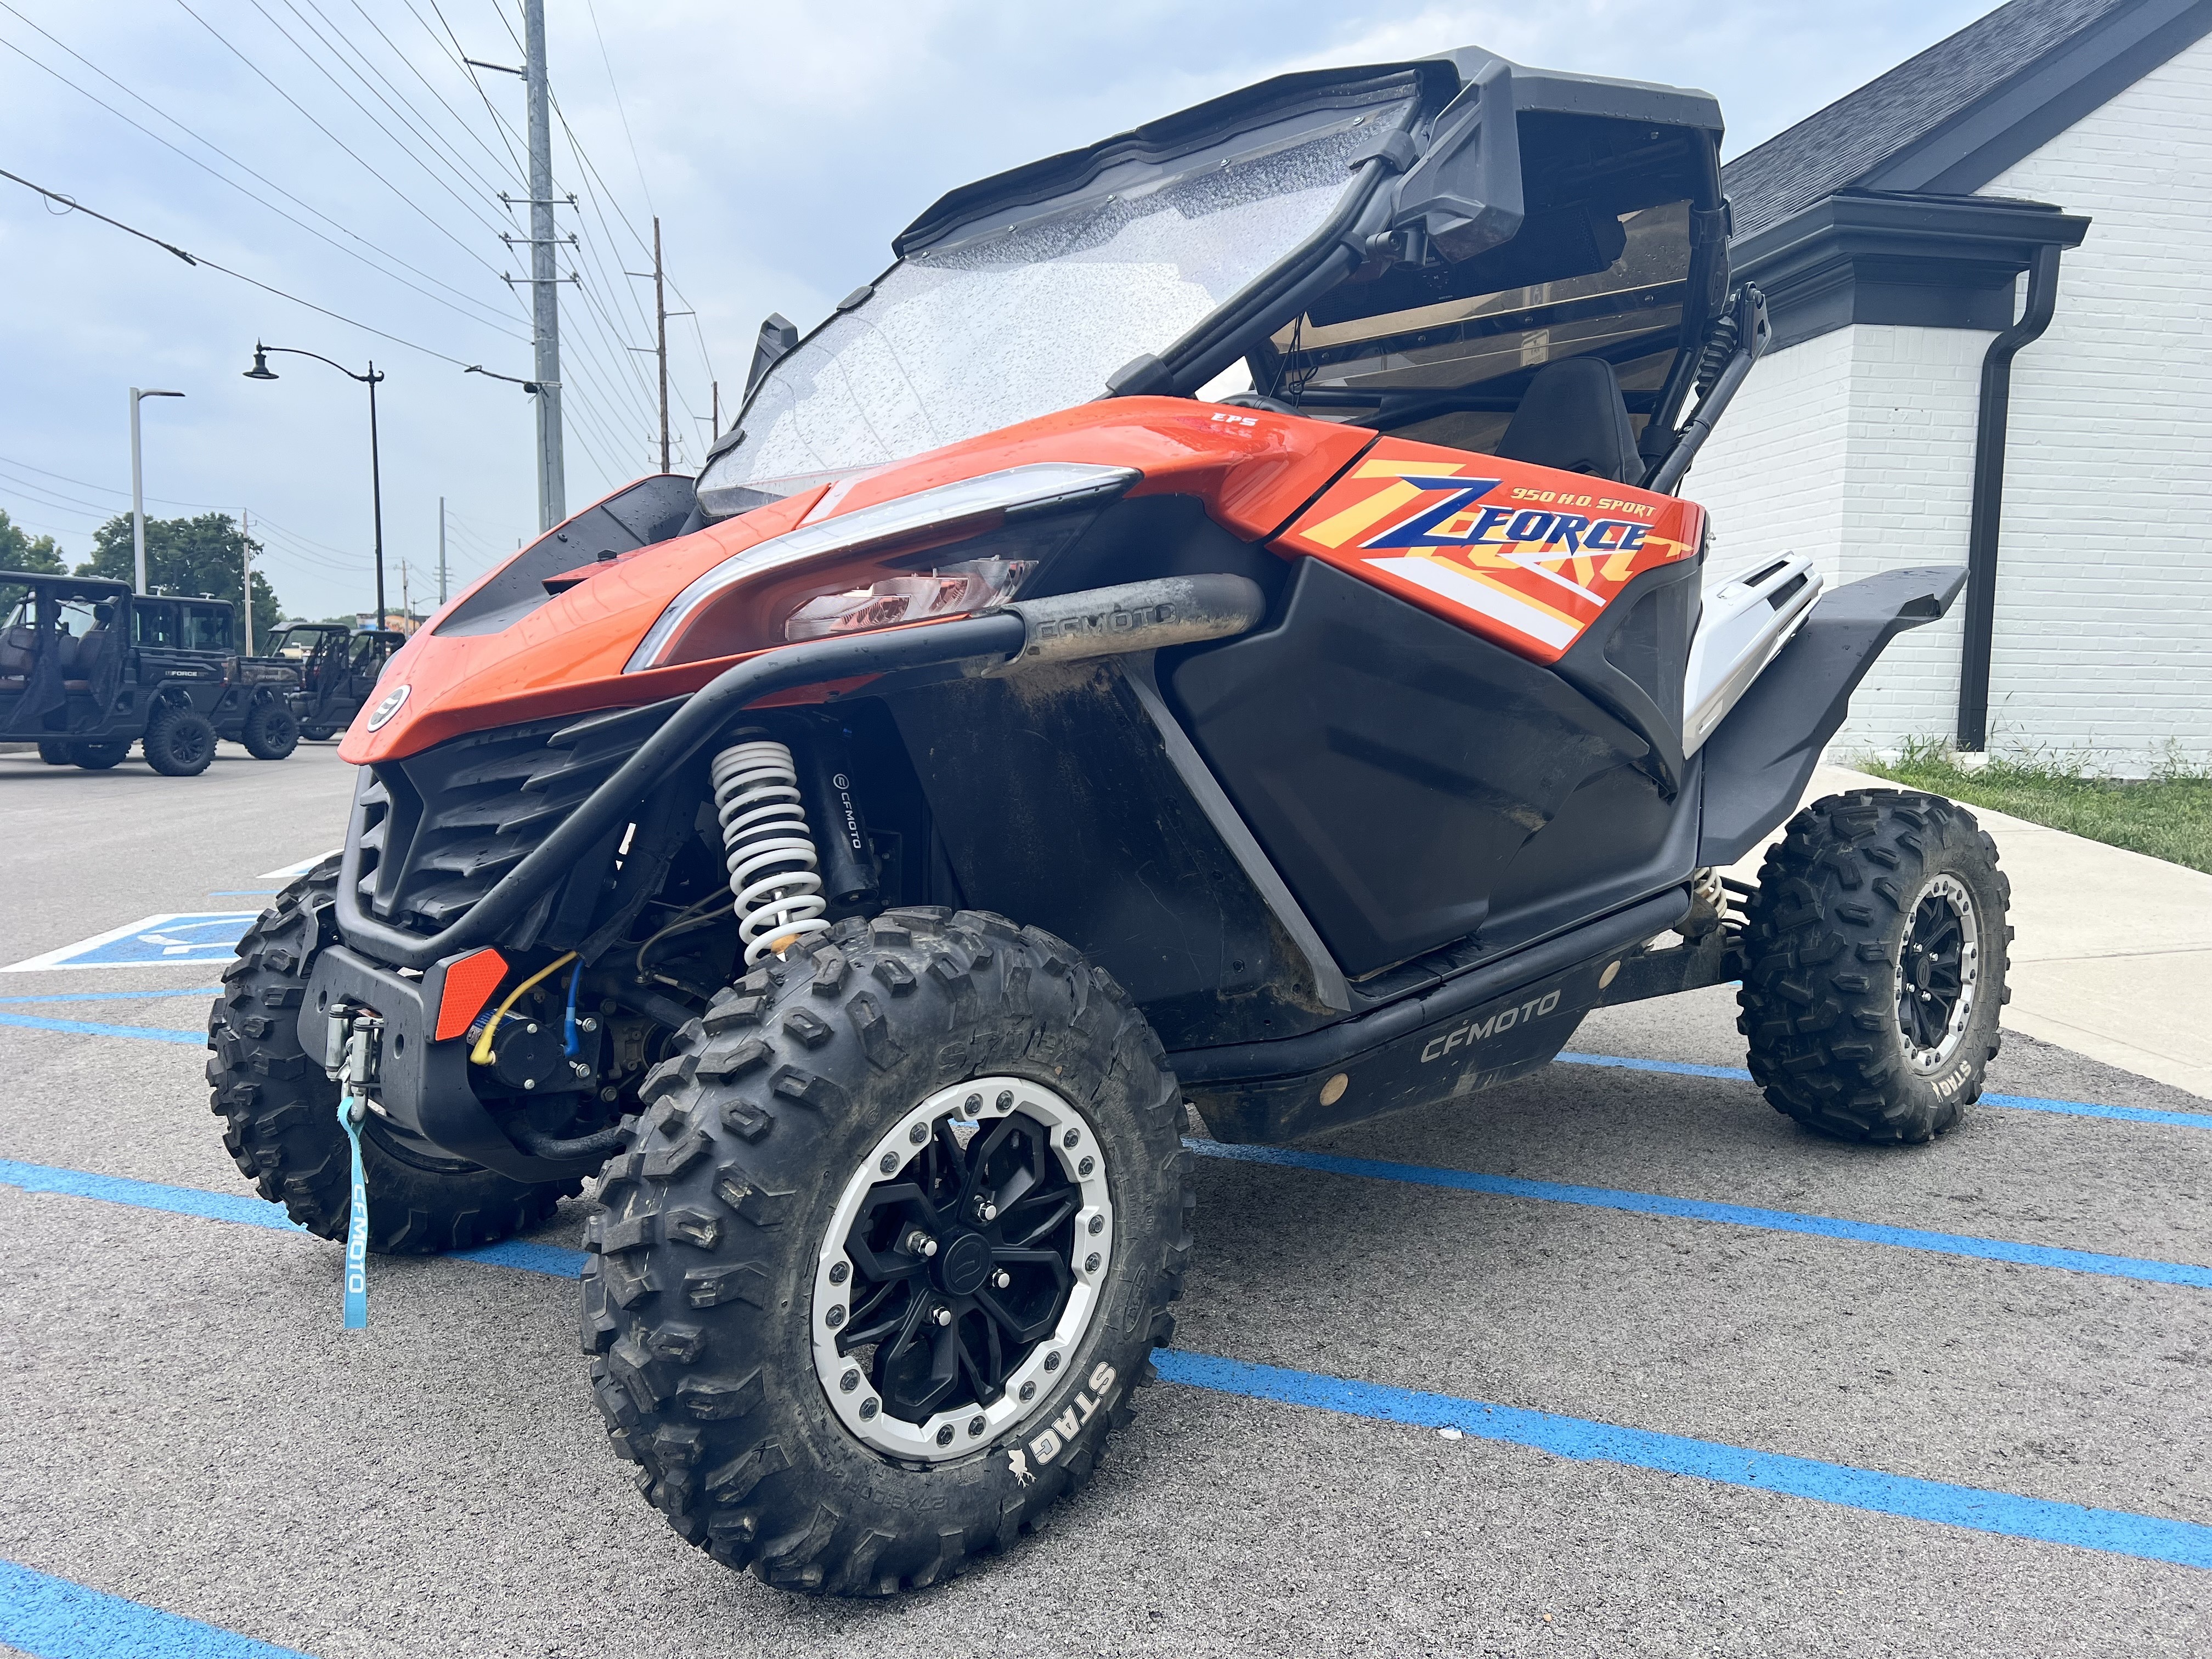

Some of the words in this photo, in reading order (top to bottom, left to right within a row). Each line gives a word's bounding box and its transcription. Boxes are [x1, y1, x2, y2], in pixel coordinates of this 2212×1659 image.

[1210, 412, 1259, 426] EPS
[1510, 487, 1556, 503] 950
[1556, 493, 1592, 507] H.O.
[1595, 496, 1657, 518] SPORT
[1035, 602, 1177, 641] CFMOTO
[841, 792, 861, 849] CFMOTO
[1420, 989, 1561, 1063] CFMOTO
[1938, 1059, 1972, 1097] STAG
[348, 1183, 367, 1294] CFMOTO
[1028, 1361, 1117, 1466] STAG
